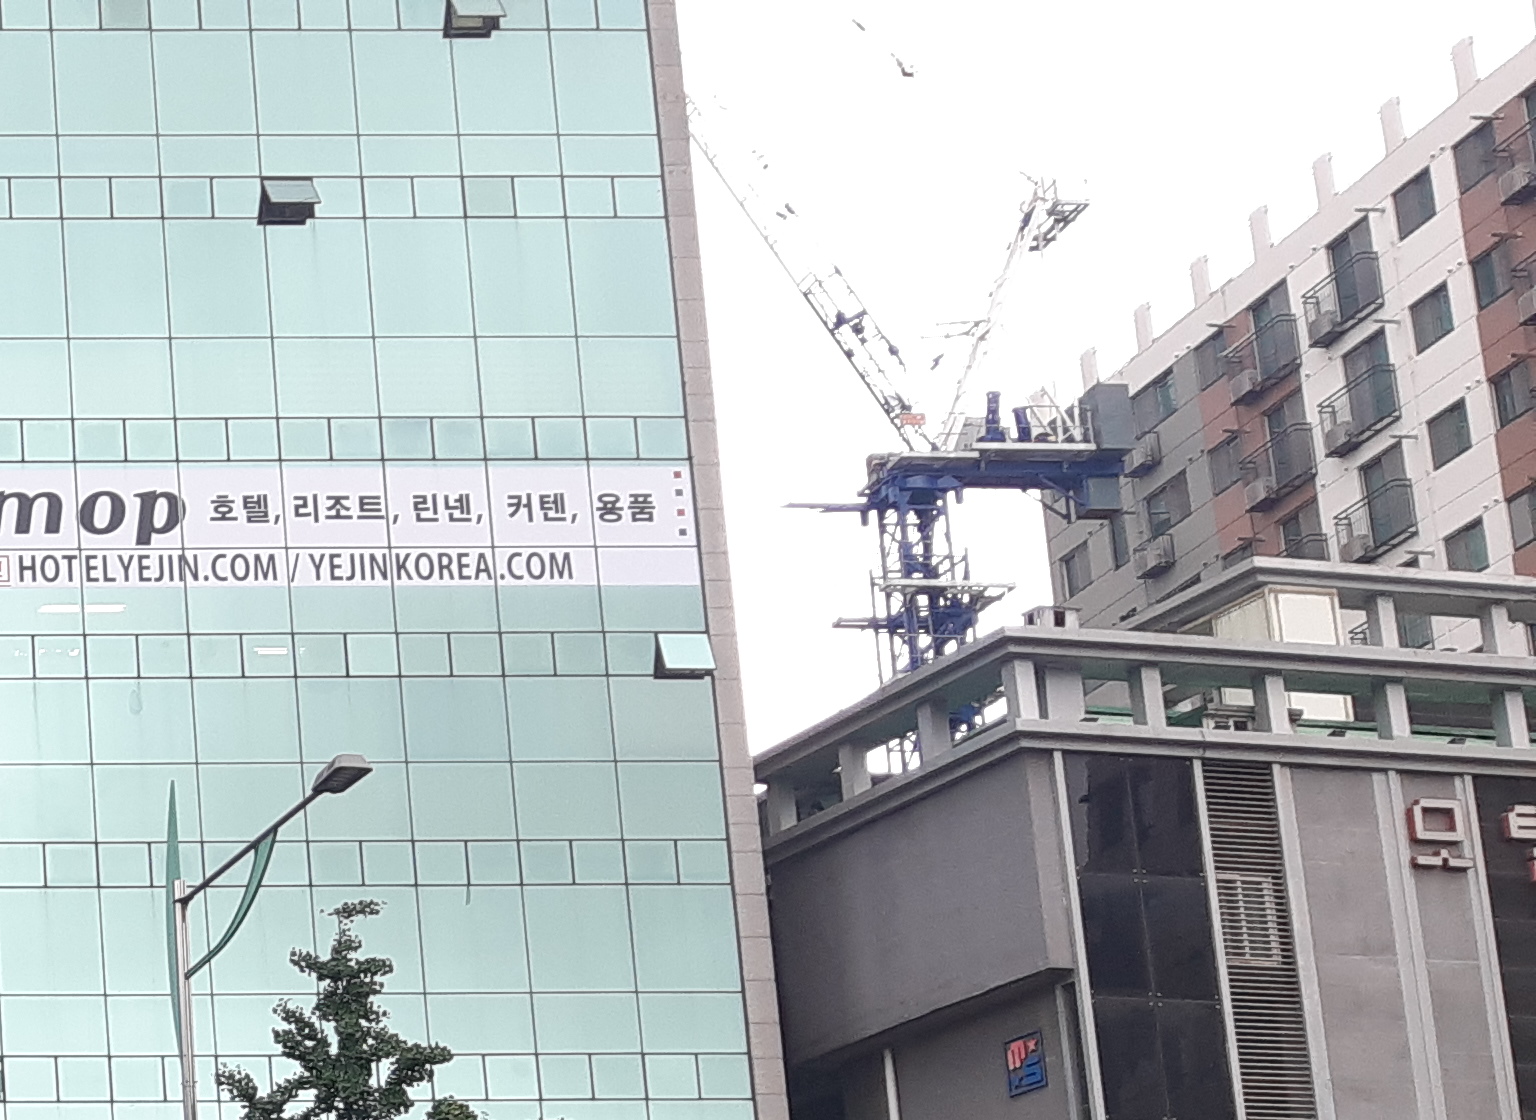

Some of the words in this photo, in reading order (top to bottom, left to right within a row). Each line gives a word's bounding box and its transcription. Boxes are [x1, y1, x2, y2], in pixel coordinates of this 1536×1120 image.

[208, 493, 281, 525] 호텔,
[412, 492, 483, 525] 린넨,
[595, 493, 657, 523] 용품
[19, 552, 278, 584] HOTELYEJIN.COM
[309, 551, 574, 582] YEJINKOREA.COM
